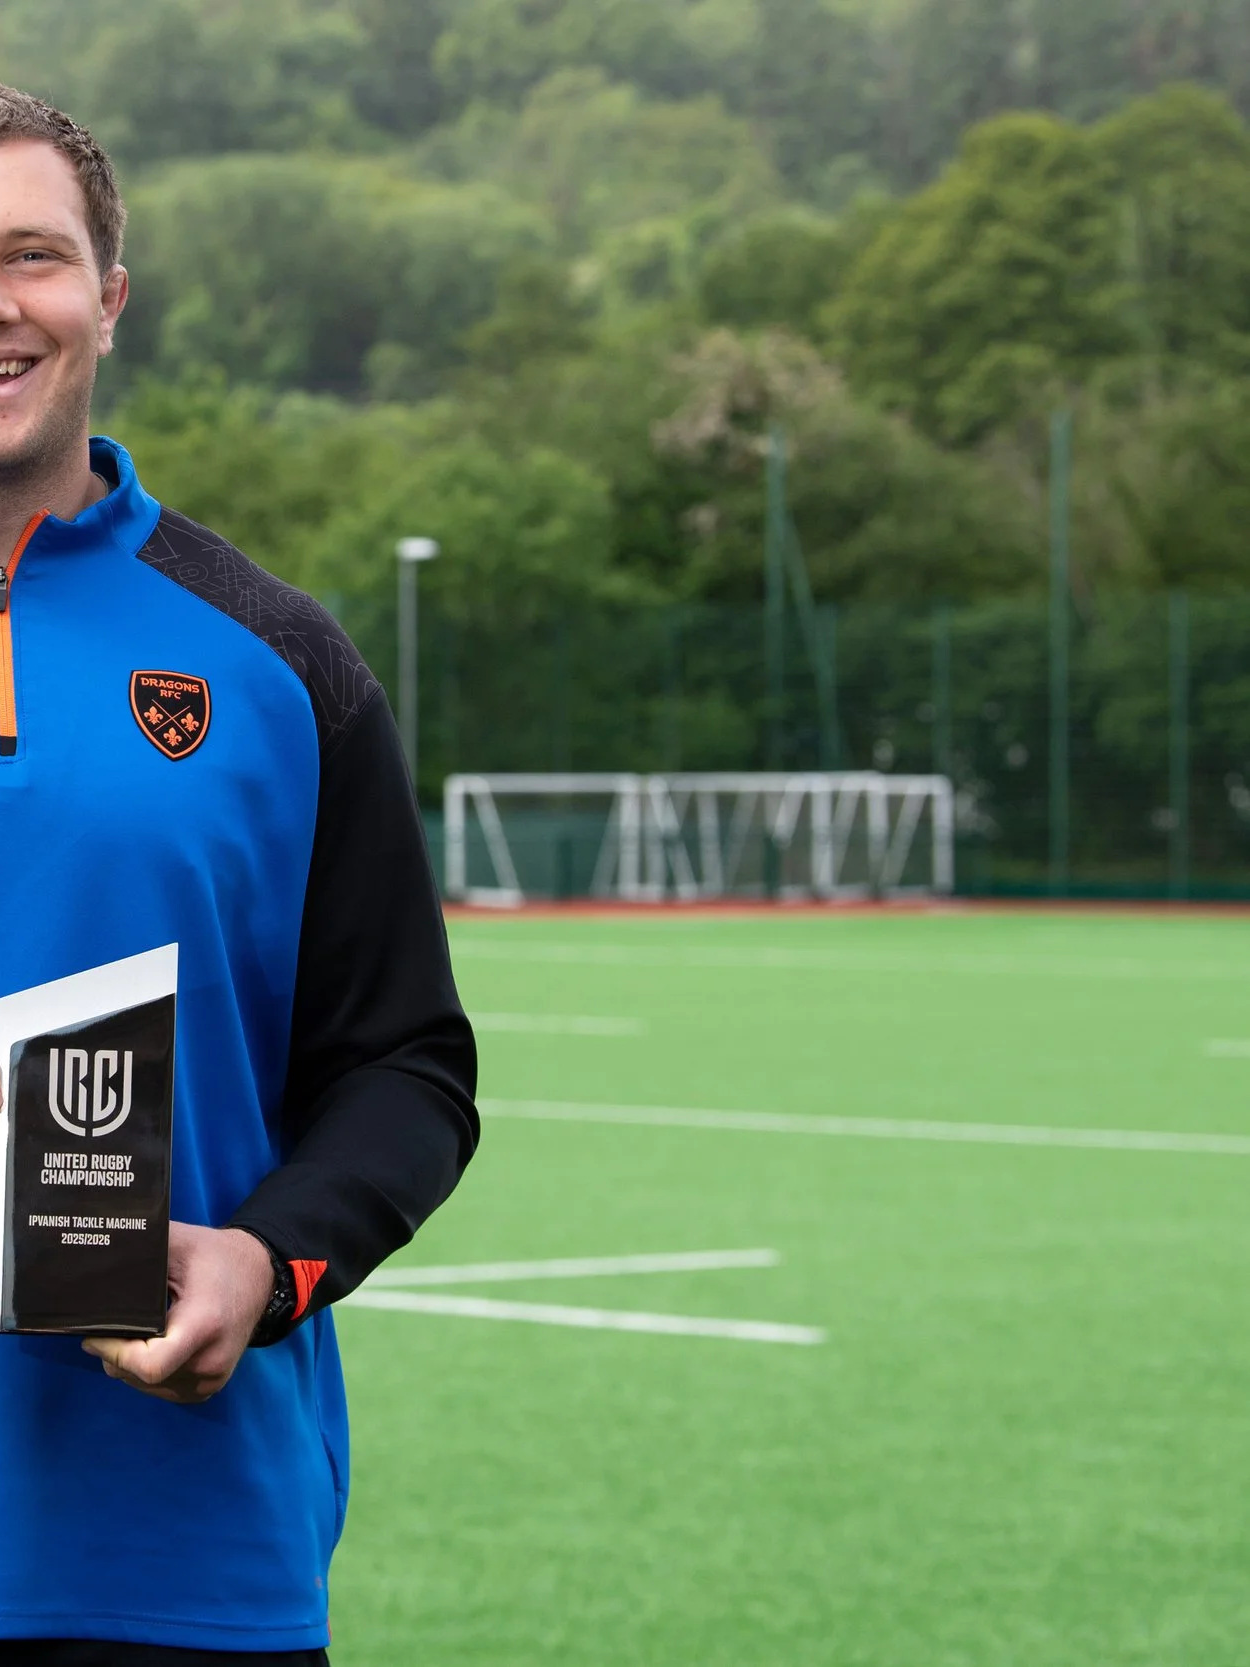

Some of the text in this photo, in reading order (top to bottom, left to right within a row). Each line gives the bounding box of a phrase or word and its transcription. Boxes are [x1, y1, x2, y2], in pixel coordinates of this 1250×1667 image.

[140, 677, 200, 694] DRAGONS
[160, 689, 182, 700] RFC
[43, 1152, 132, 1171] UNITED RUGBY
[40, 1169, 135, 1187] CHAMPIONSHIP
[28, 1214, 147, 1230] IPVANISH TACKLE MACHINE
[61, 1232, 111, 1246] 2025/2026
